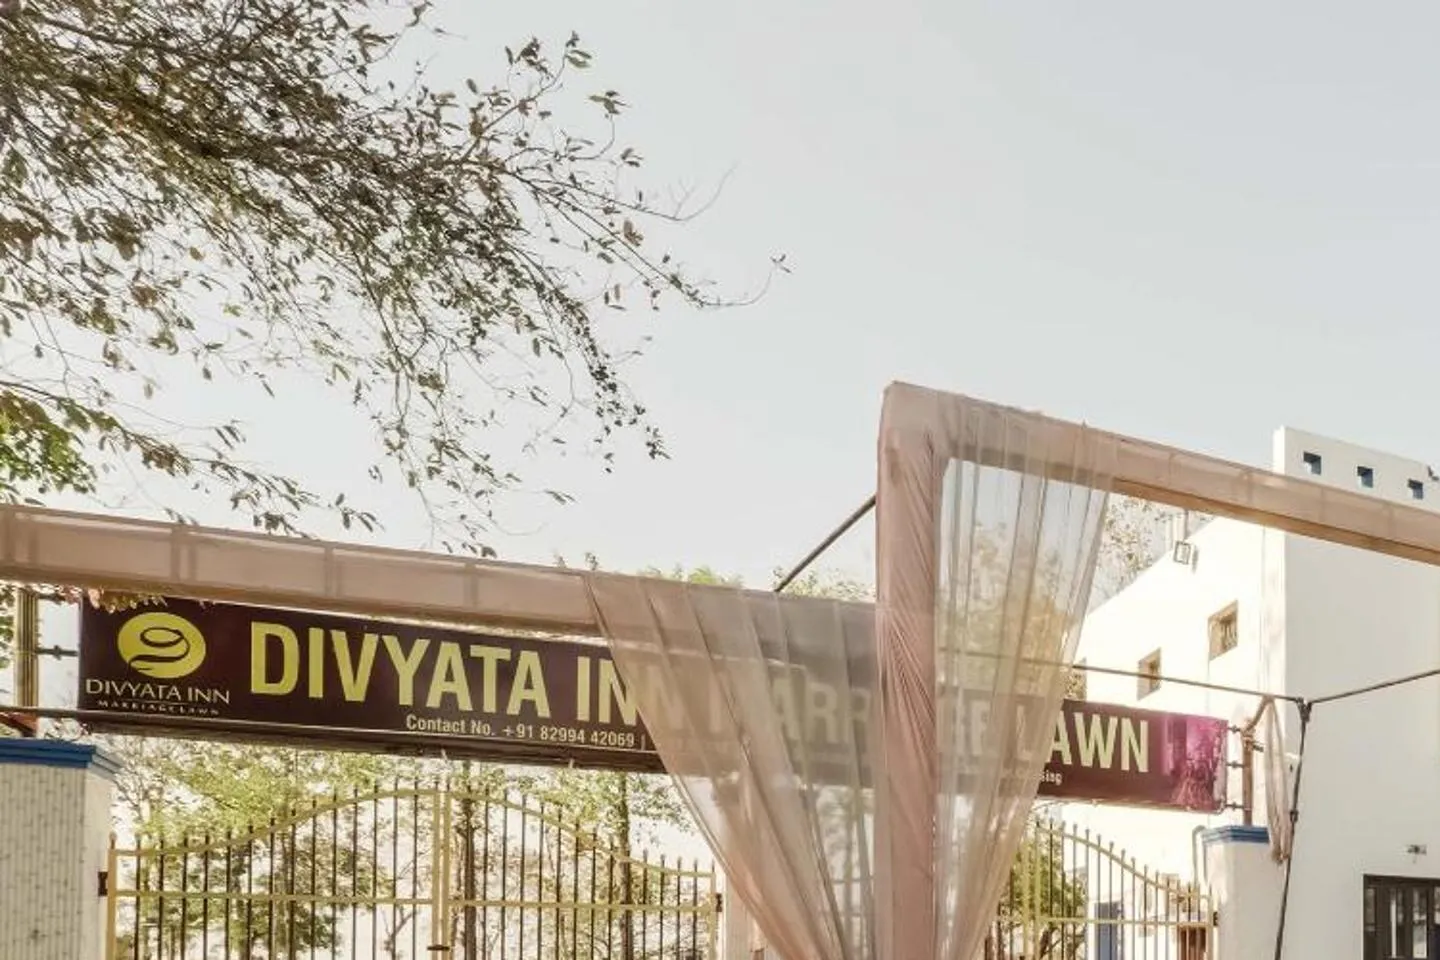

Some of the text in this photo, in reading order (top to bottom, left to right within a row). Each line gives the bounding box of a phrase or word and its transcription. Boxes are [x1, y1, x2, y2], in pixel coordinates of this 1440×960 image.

[250, 620, 551, 720] DIVYATA
[85, 678, 230, 705] DIVYATA INN
[405, 713, 466, 735] Contact
[470, 720, 496, 737] No.
[540, 726, 586, 744] 82994
[590, 730, 635, 748] 42069
